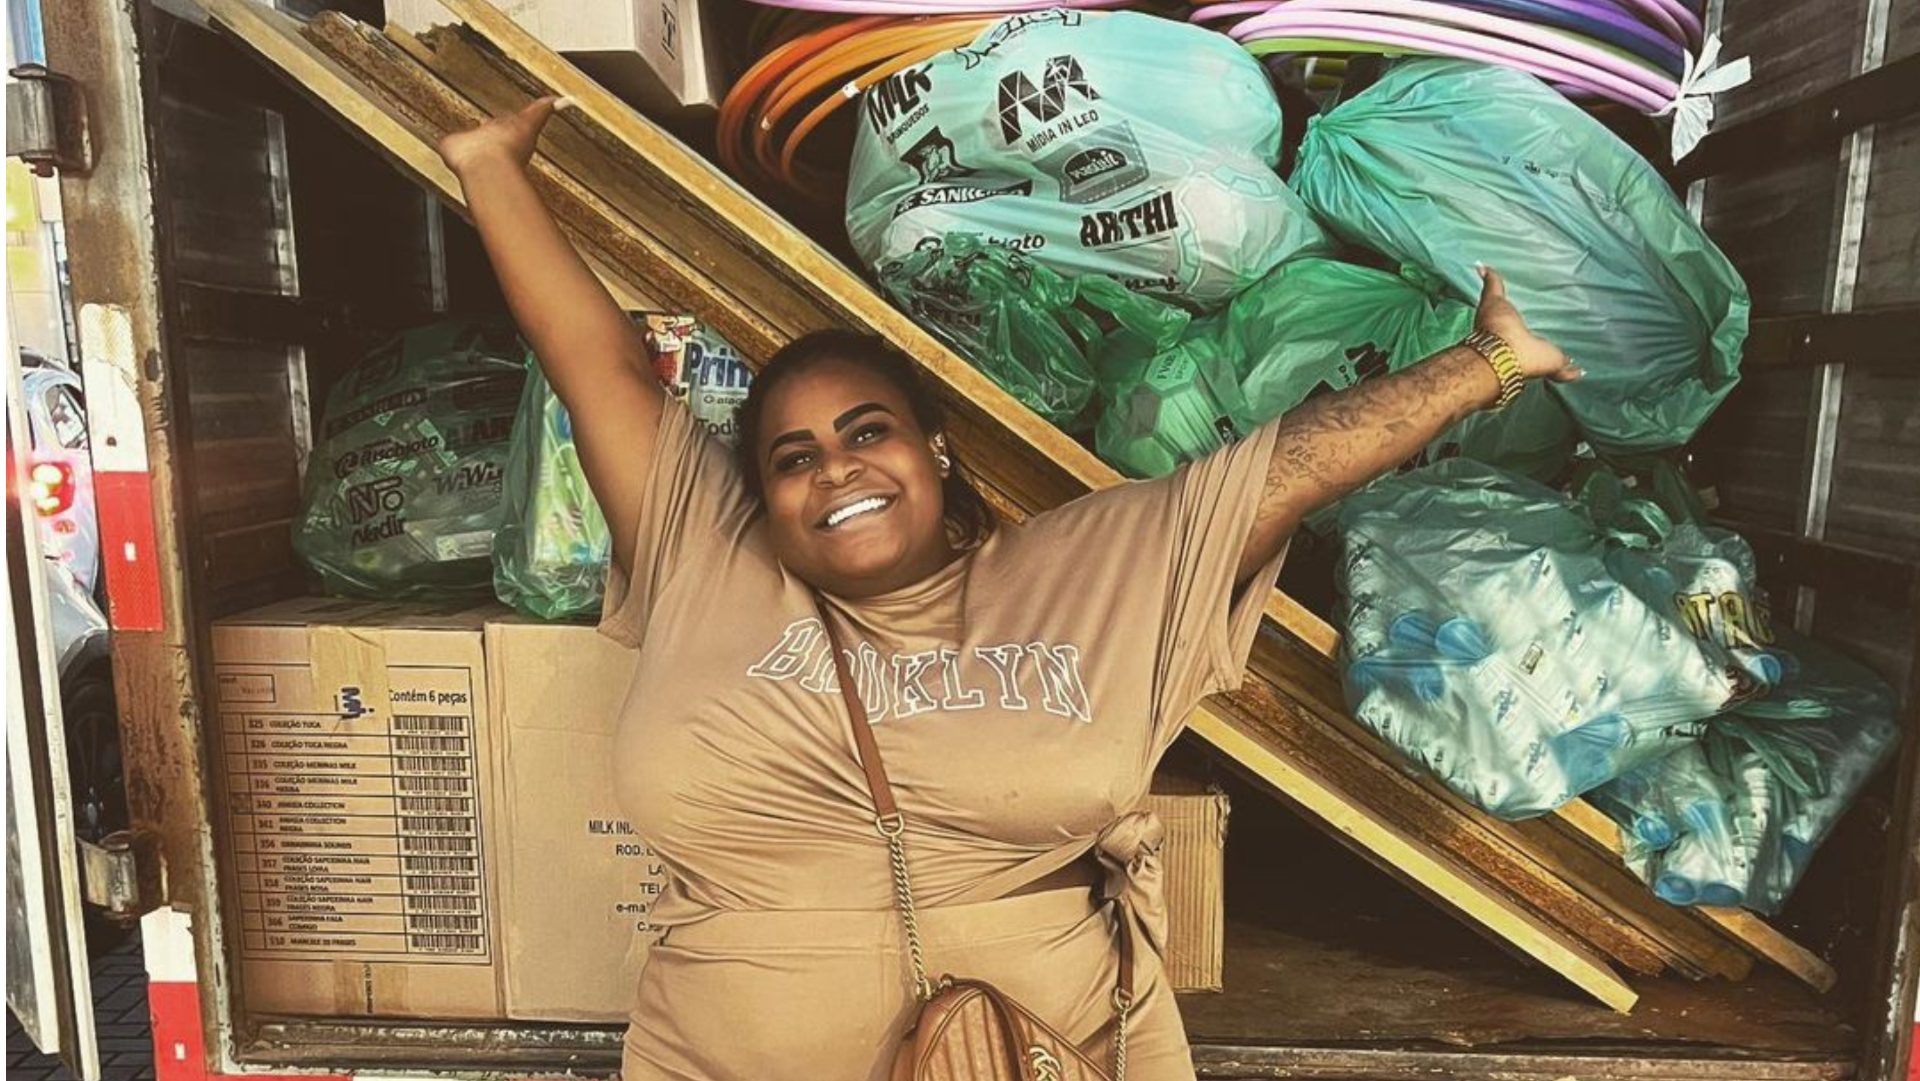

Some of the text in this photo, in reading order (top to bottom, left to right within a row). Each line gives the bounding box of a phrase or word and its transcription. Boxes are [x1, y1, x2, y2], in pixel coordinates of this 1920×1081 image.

[1058, 121, 1073, 136] IN
[1077, 108, 1100, 129] LED
[1079, 191, 1179, 248] ARTHI
[388, 688, 468, 706] Contém 6 peças
[588, 820, 614, 834] MILK
